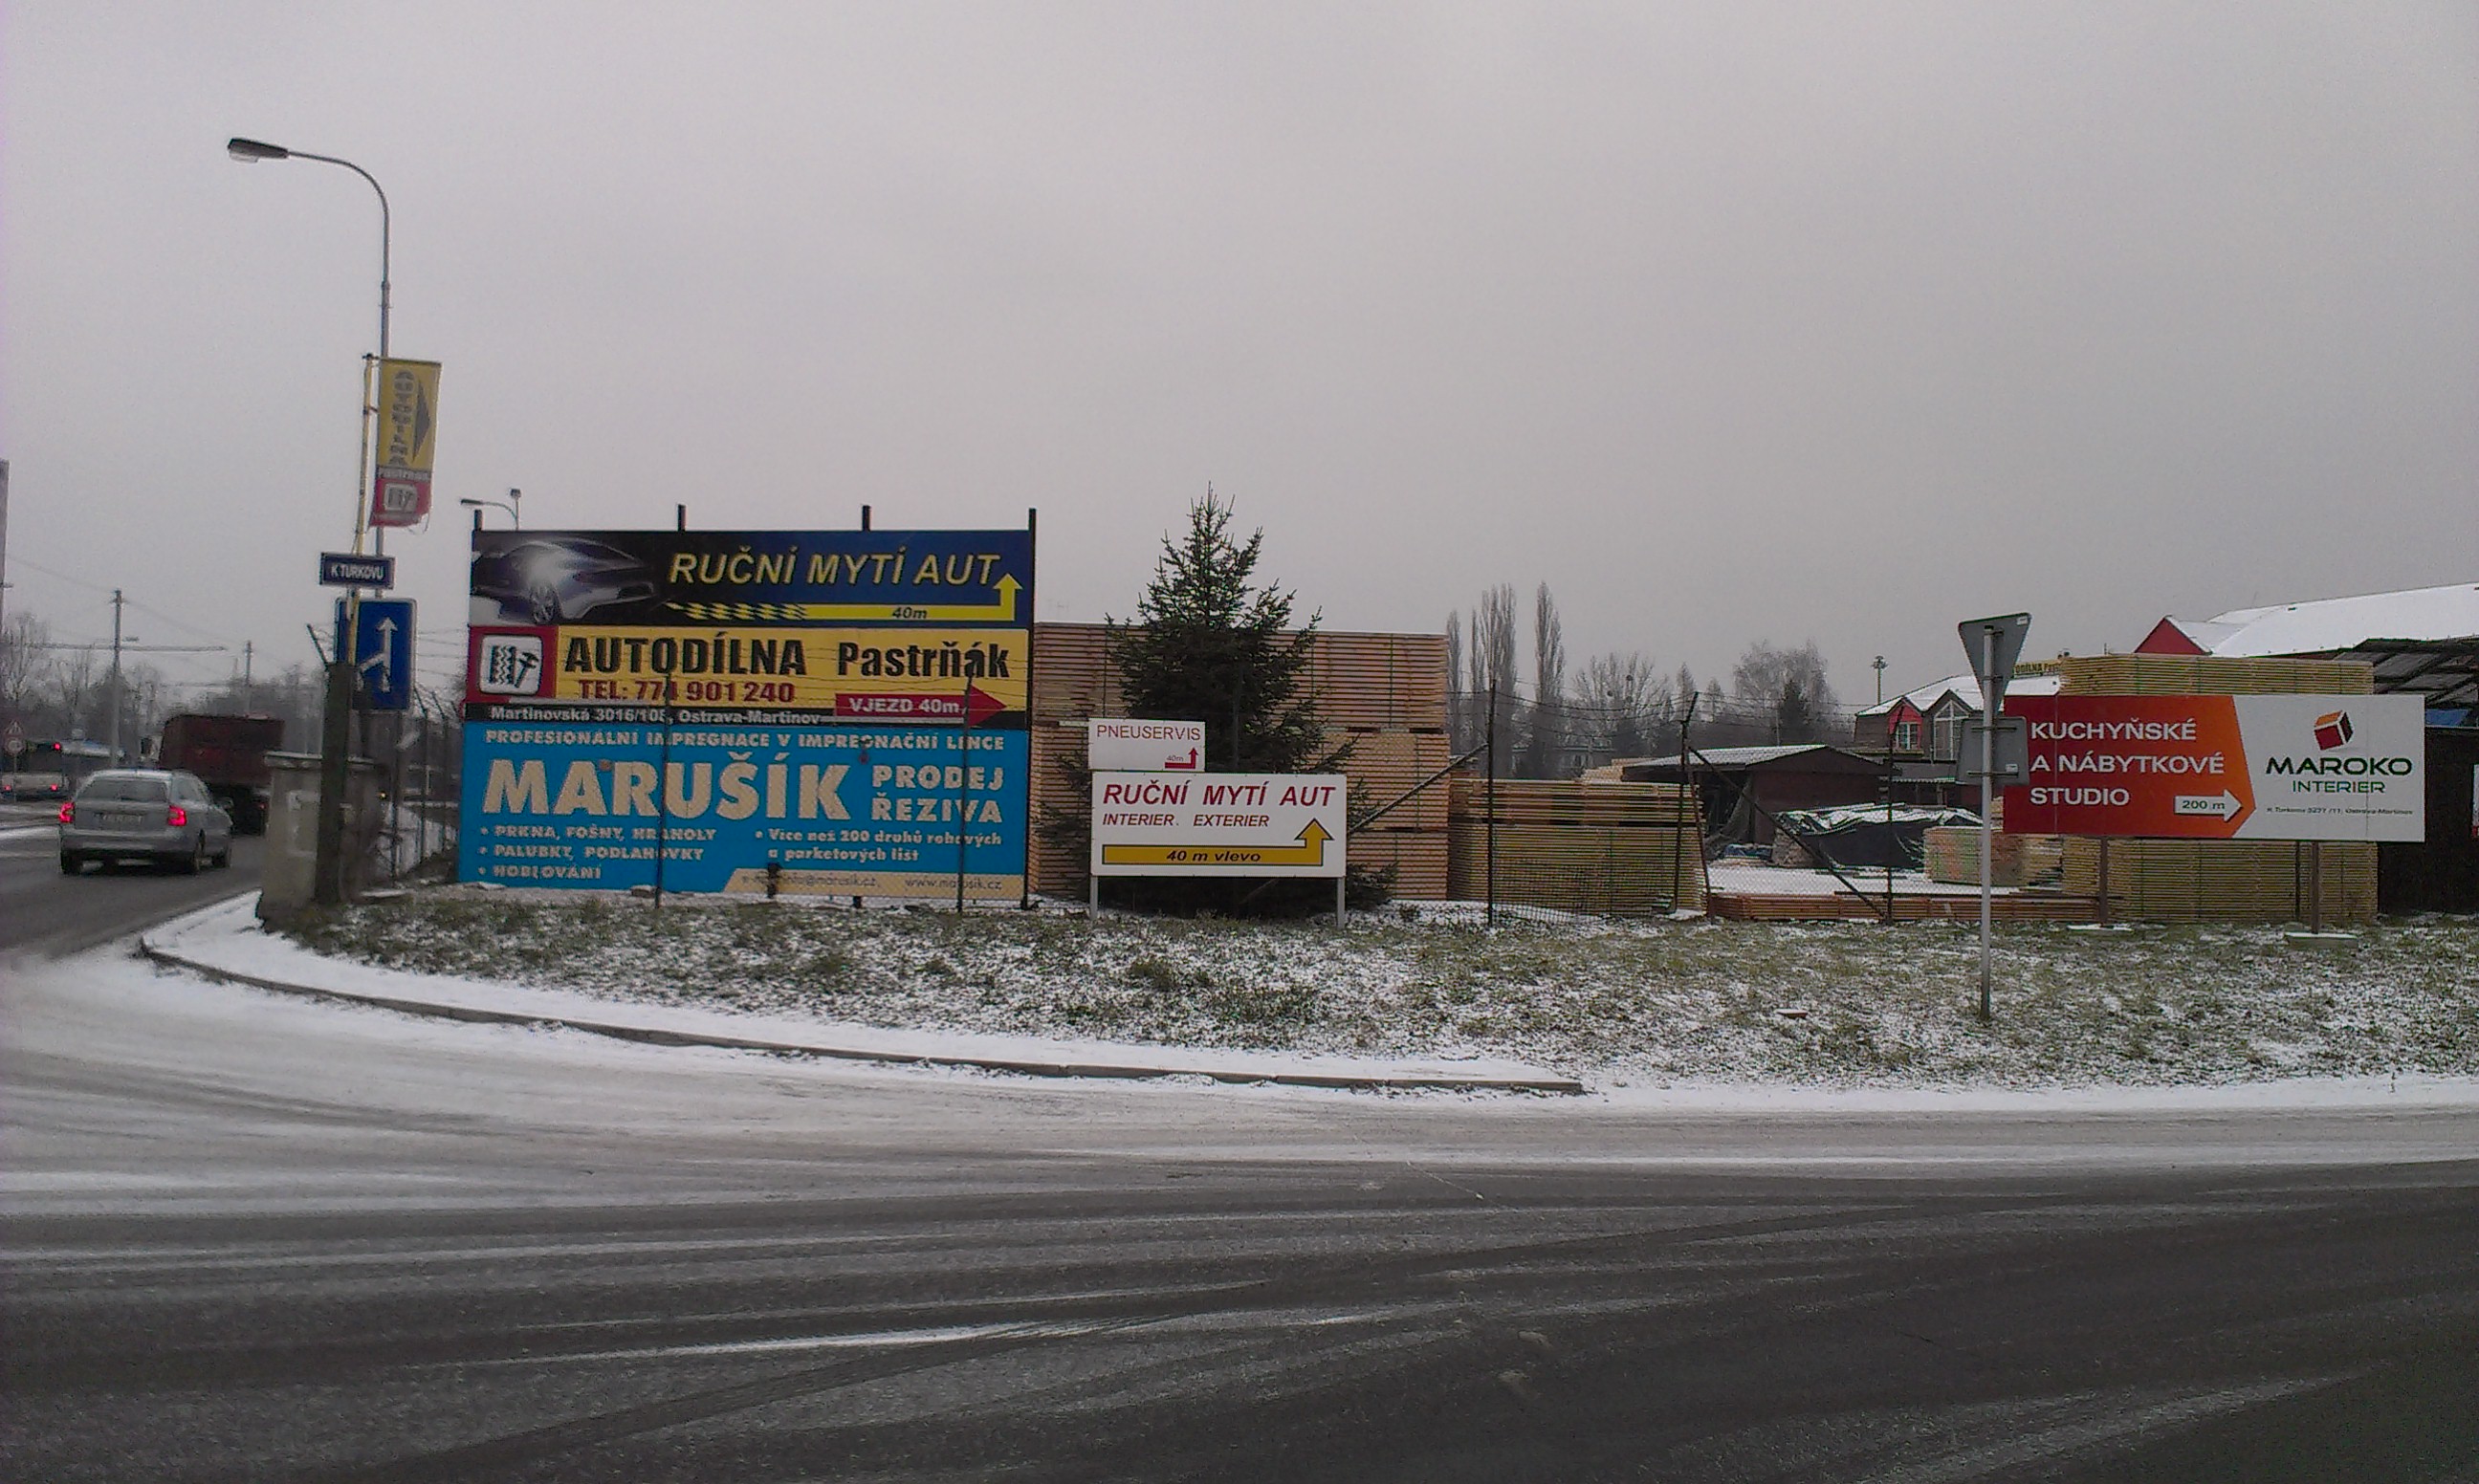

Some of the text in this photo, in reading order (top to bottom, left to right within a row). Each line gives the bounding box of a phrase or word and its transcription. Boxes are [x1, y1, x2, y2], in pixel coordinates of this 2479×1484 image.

[331, 563, 384, 580] K TURKOVU
[669, 545, 1001, 585] RUČNÍ MYTÍ AUT
[891, 607, 929, 620] 40m
[564, 631, 1010, 678] AUTODÍLNA Pastrňák
[578, 679, 628, 701] TEL:
[686, 681, 735, 703] 901
[742, 682, 796, 704] 240
[848, 697, 959, 713] VJEZD 40m
[491, 705, 591, 721] Martinovská
[678, 709, 821, 726] Ostrava-Martinov
[1096, 724, 1201, 741] PNEUSERVIS
[2030, 717, 2197, 741] KUCHYŇSKÉ
[485, 728, 1004, 751] PROFESIONÁLNÍ IMPREGNACE V IMPREGNAČNÍ LINCE
[1166, 754, 1184, 763] 40m
[2029, 750, 2225, 775] A NÁBYTKOVÉ
[2265, 756, 2413, 775] MAROKO
[482, 751, 851, 820] MARUŠÍK
[871, 764, 1003, 792] PRODEJ
[2293, 780, 2386, 794] INTERIER
[1102, 779, 1337, 807] RUČNÍ MYTÍ AUT
[2029, 787, 2131, 806] STUDIO
[870, 792, 1002, 823] ŘEZIVA
[2182, 799, 2226, 810] 200 m
[1193, 815, 1270, 828] EXTERIER
[494, 824, 560, 841] PRKNA,
[565, 822, 625, 842] FOŠNY,
[806, 829, 837, 842] než
[840, 829, 871, 843] 200
[874, 829, 923, 844] druhů
[494, 843, 704, 862] PALUBKY, PODLAHOVKY
[767, 848, 779, 859] a
[784, 846, 887, 863] parketových
[1166, 850, 1261, 862] 40 m vlevo
